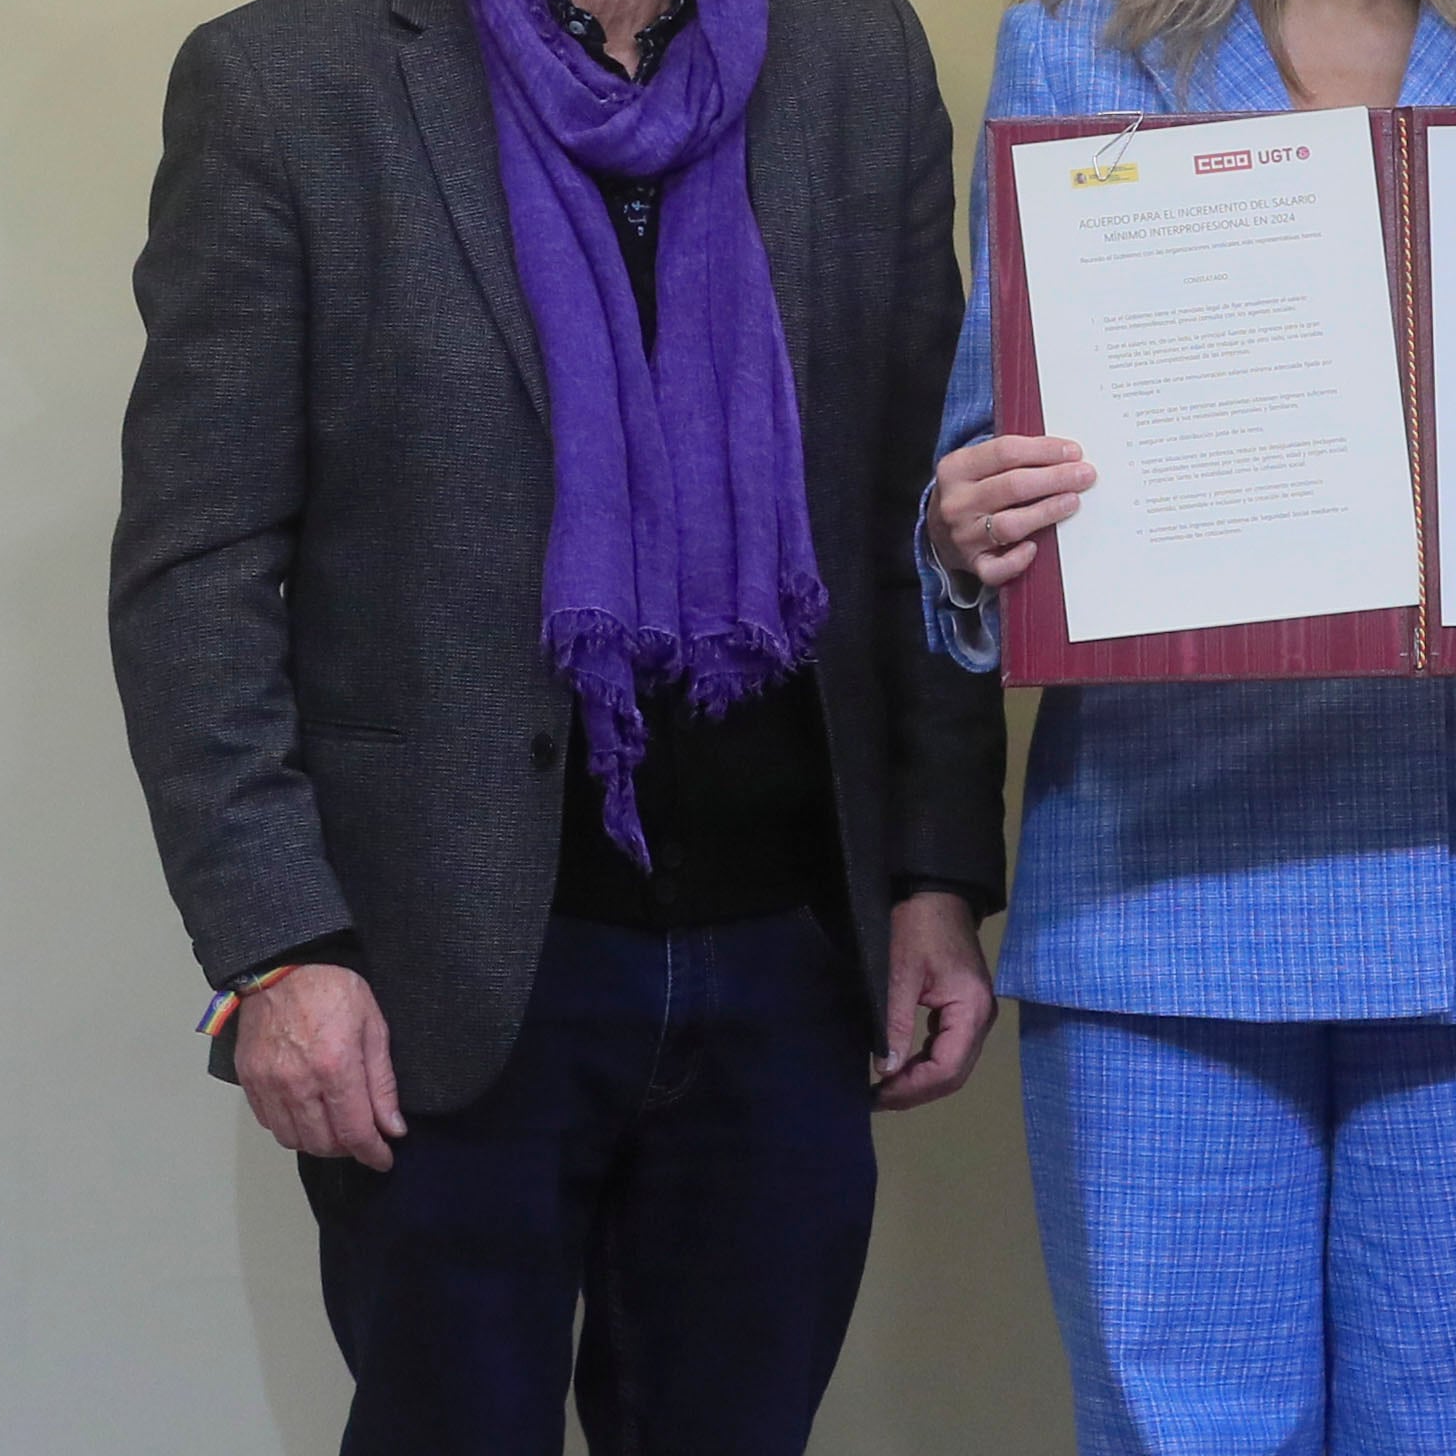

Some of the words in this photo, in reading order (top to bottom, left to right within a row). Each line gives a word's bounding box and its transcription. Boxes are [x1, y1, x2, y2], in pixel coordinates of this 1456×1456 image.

[1196, 151, 1251, 172] CCOO
[1258, 148, 1293, 164] UGT
[1079, 213, 1130, 230] ACUERDO
[1133, 211, 1161, 224] PARA
[1163, 209, 1176, 220] EL
[1177, 201, 1248, 218] INCREMENTO
[1250, 198, 1269, 211] DEL
[1272, 194, 1317, 208] SALARIO
[1149, 217, 1251, 238] INTERPROFESIONAL
[1253, 215, 1268, 226] EN
[1270, 212, 1295, 225] 2024
